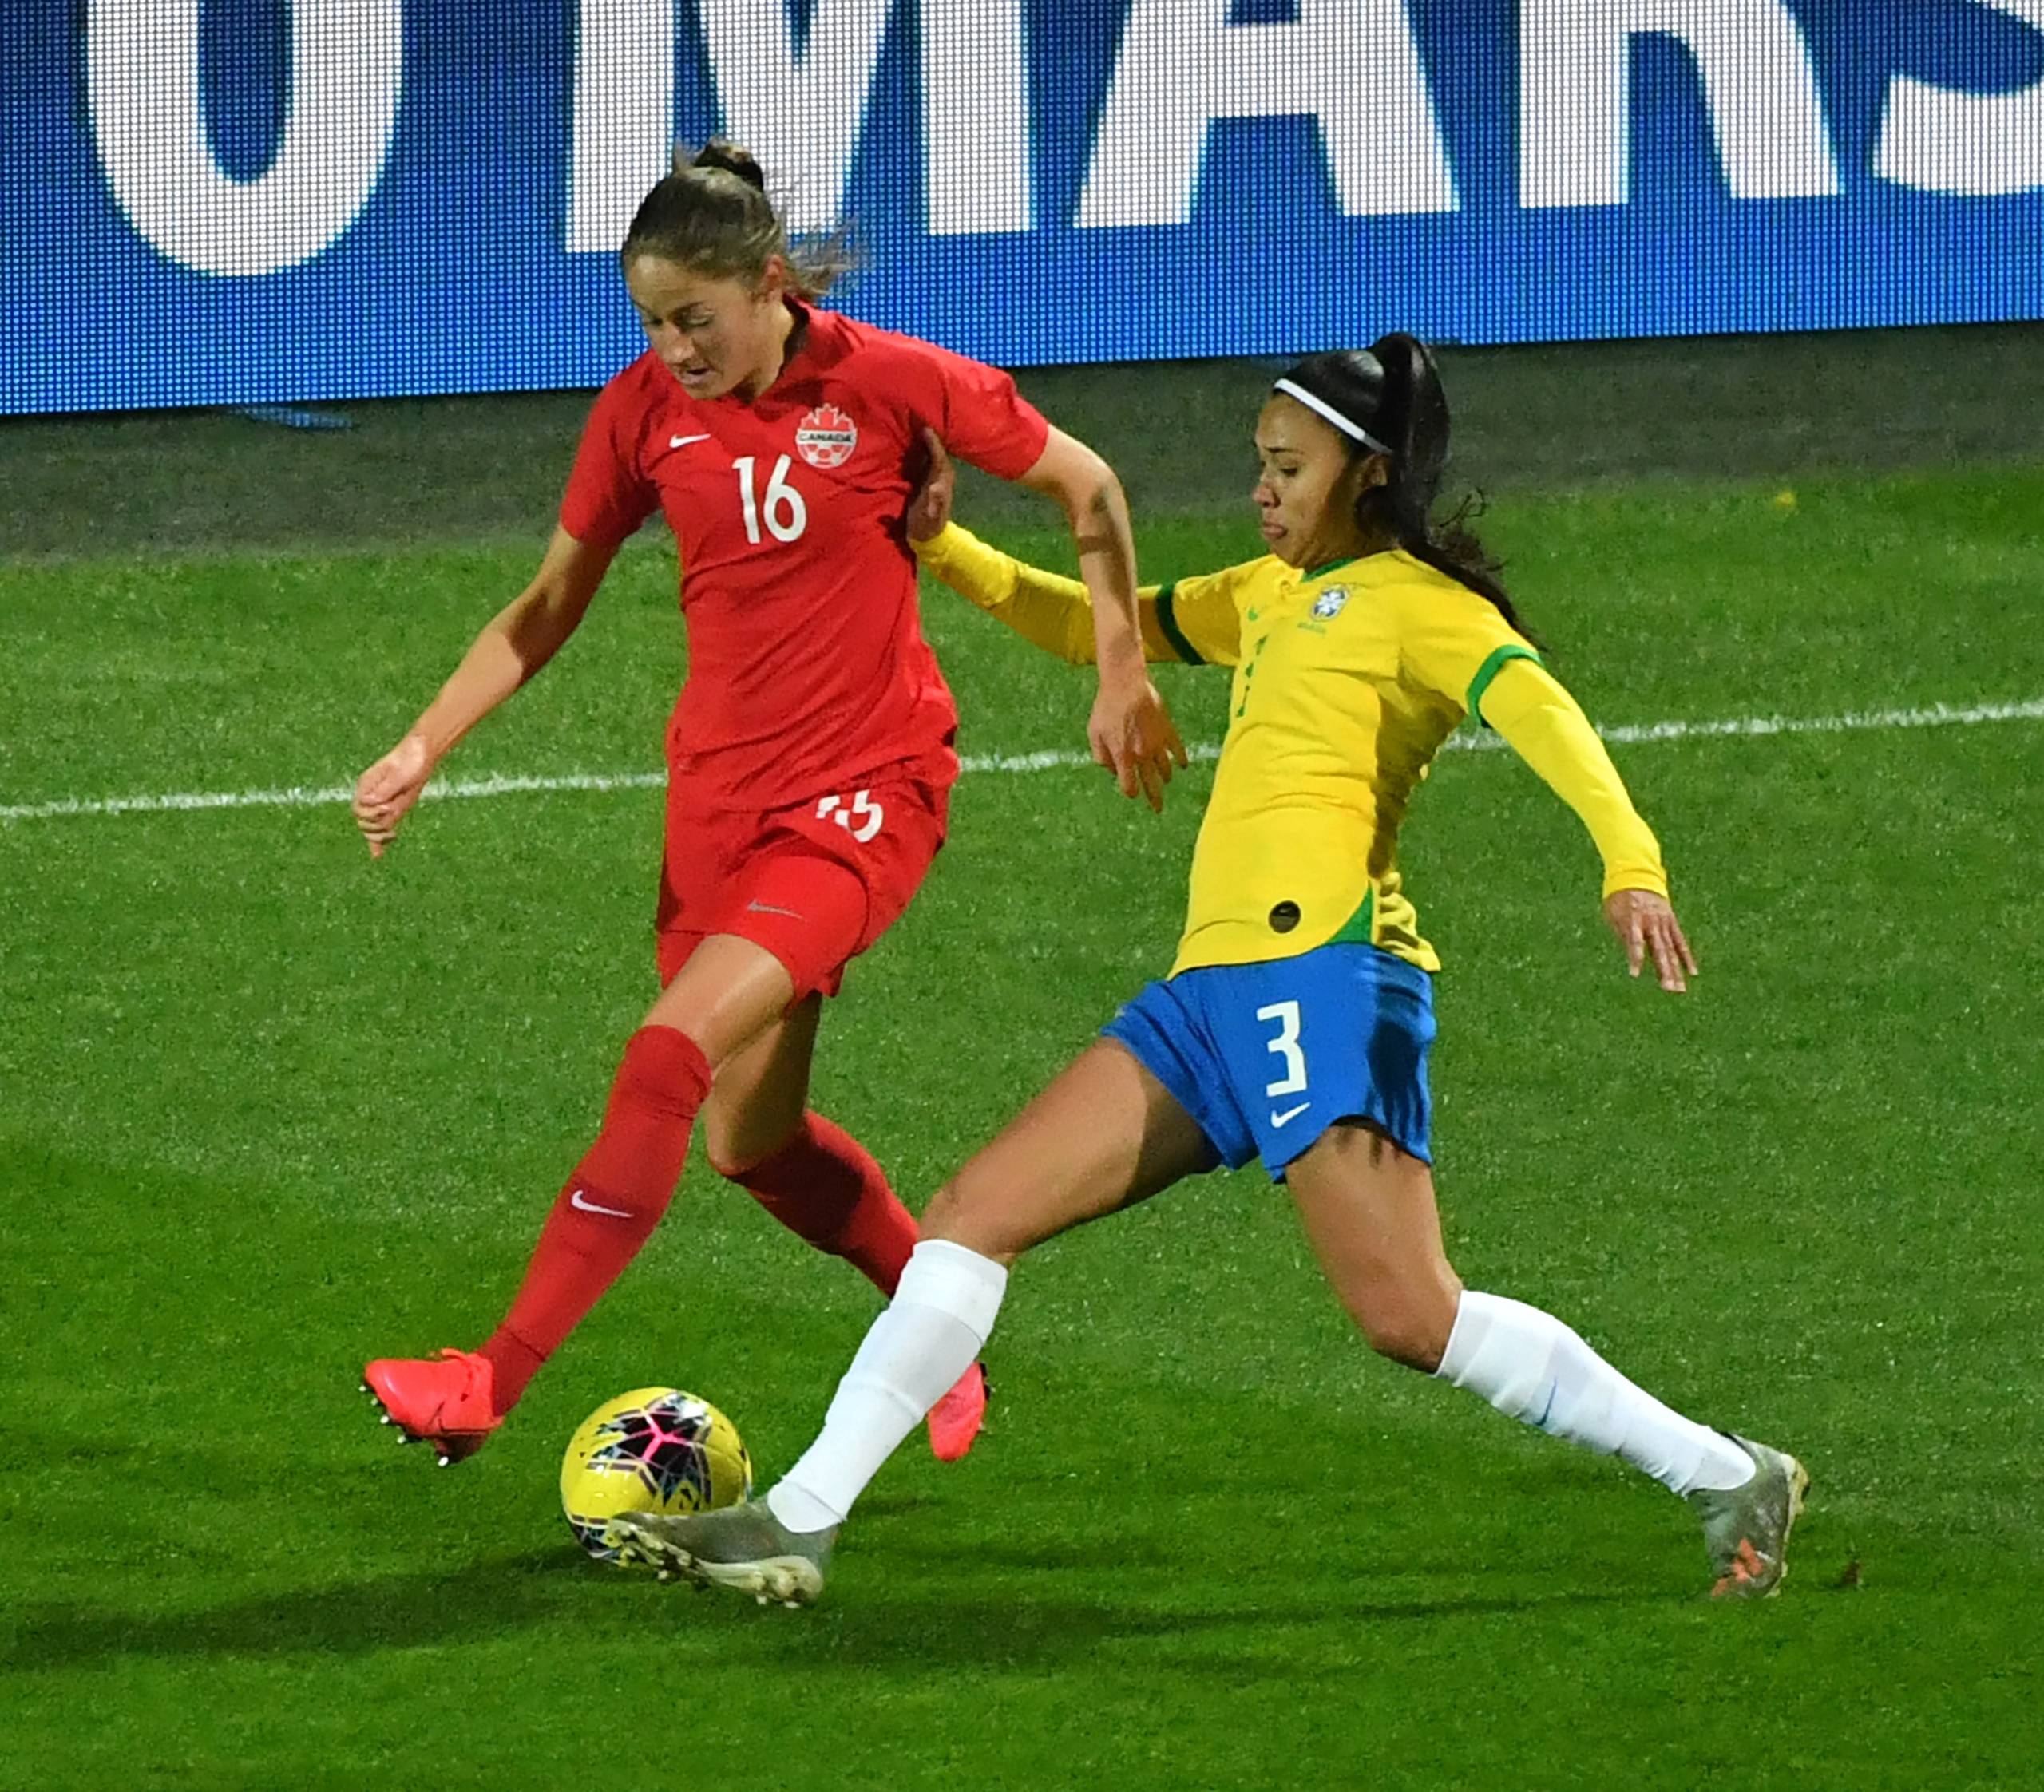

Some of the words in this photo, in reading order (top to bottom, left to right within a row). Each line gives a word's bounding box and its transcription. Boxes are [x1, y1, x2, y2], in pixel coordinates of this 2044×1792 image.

[799, 433, 853, 443] CANADA
[731, 453, 807, 544] 16
[1256, 1000, 1308, 1098] 3
